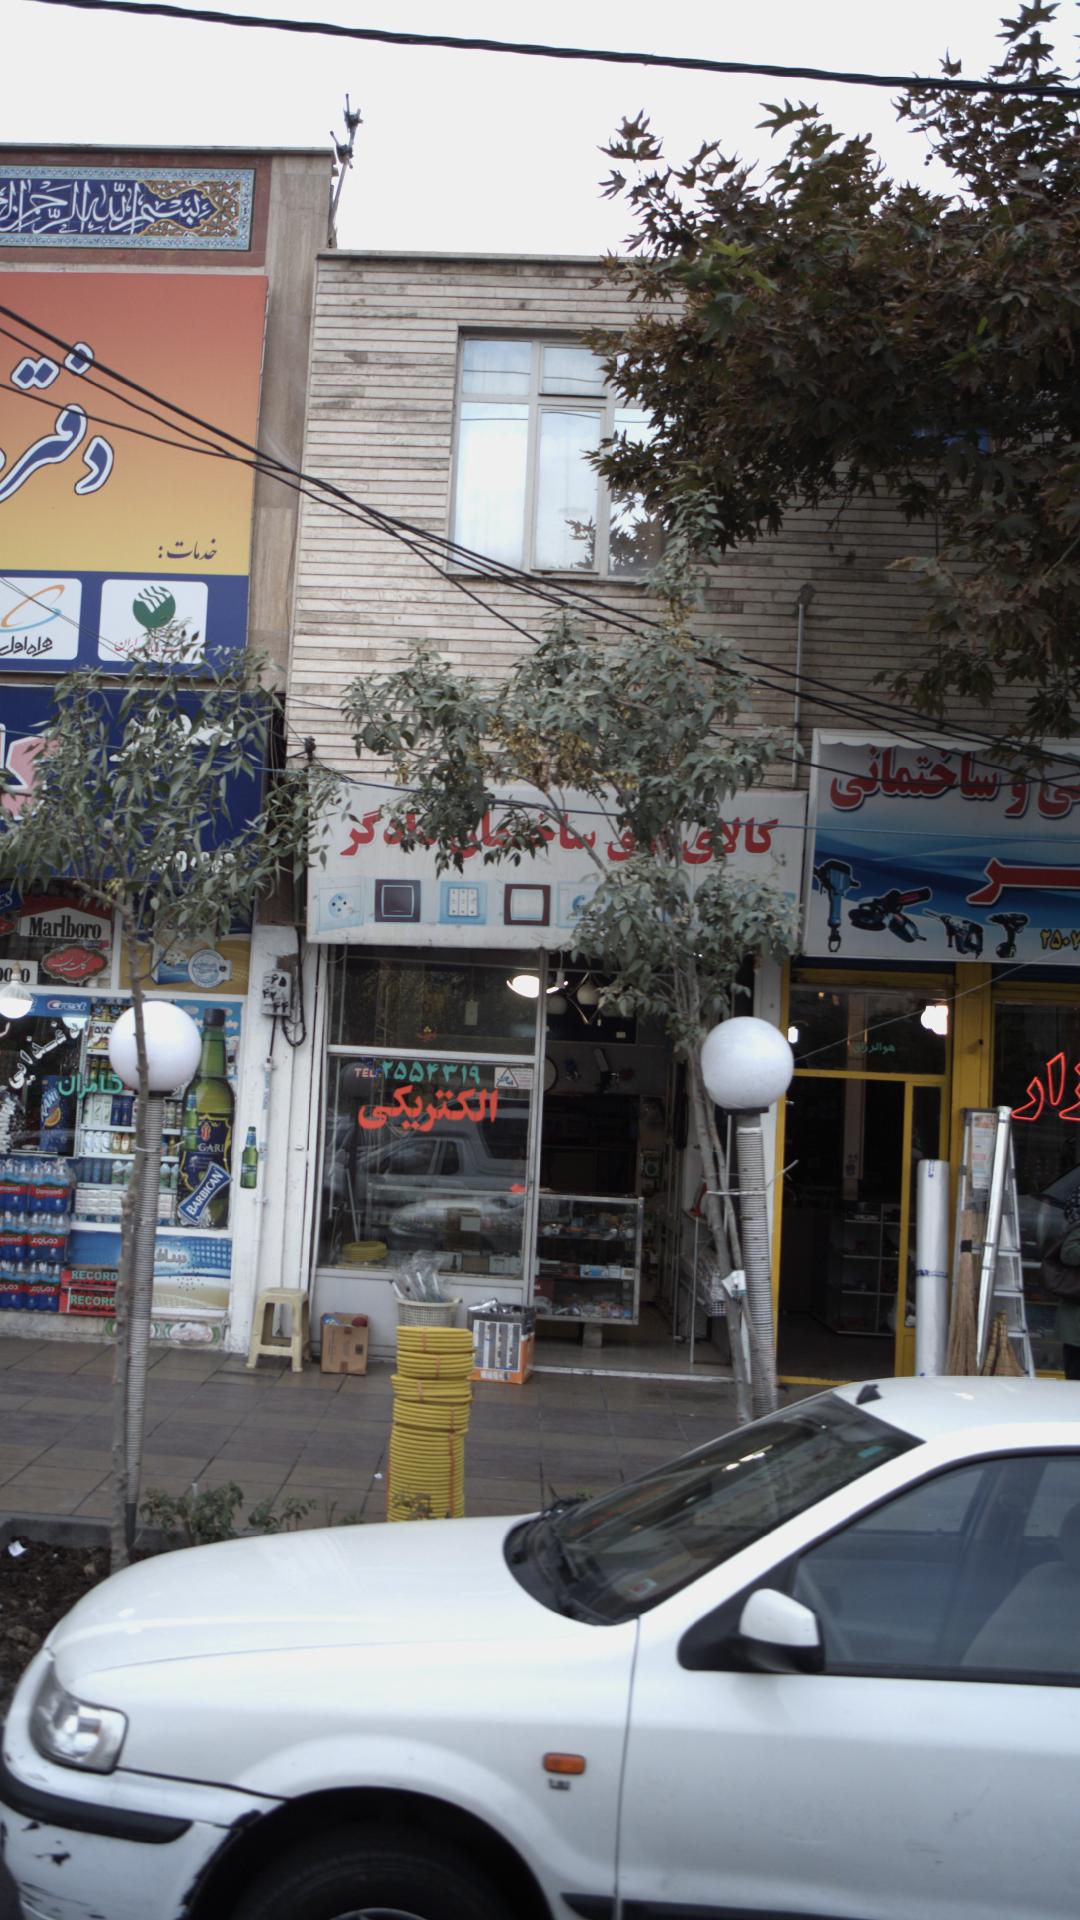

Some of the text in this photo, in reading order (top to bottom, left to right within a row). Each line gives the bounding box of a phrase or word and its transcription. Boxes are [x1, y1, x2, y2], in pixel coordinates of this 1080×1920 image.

[829, 746, 1000, 811] ساختمانی
[29, 915, 102, 939] Marlboro
[47, 1000, 87, 1016] Crest
[58, 1072, 123, 1099] کامران
[357, 1083, 499, 1132] الکتریکی
[186, 1169, 225, 1216] BARBICAN
[71, 1270, 119, 1281] RECORD
